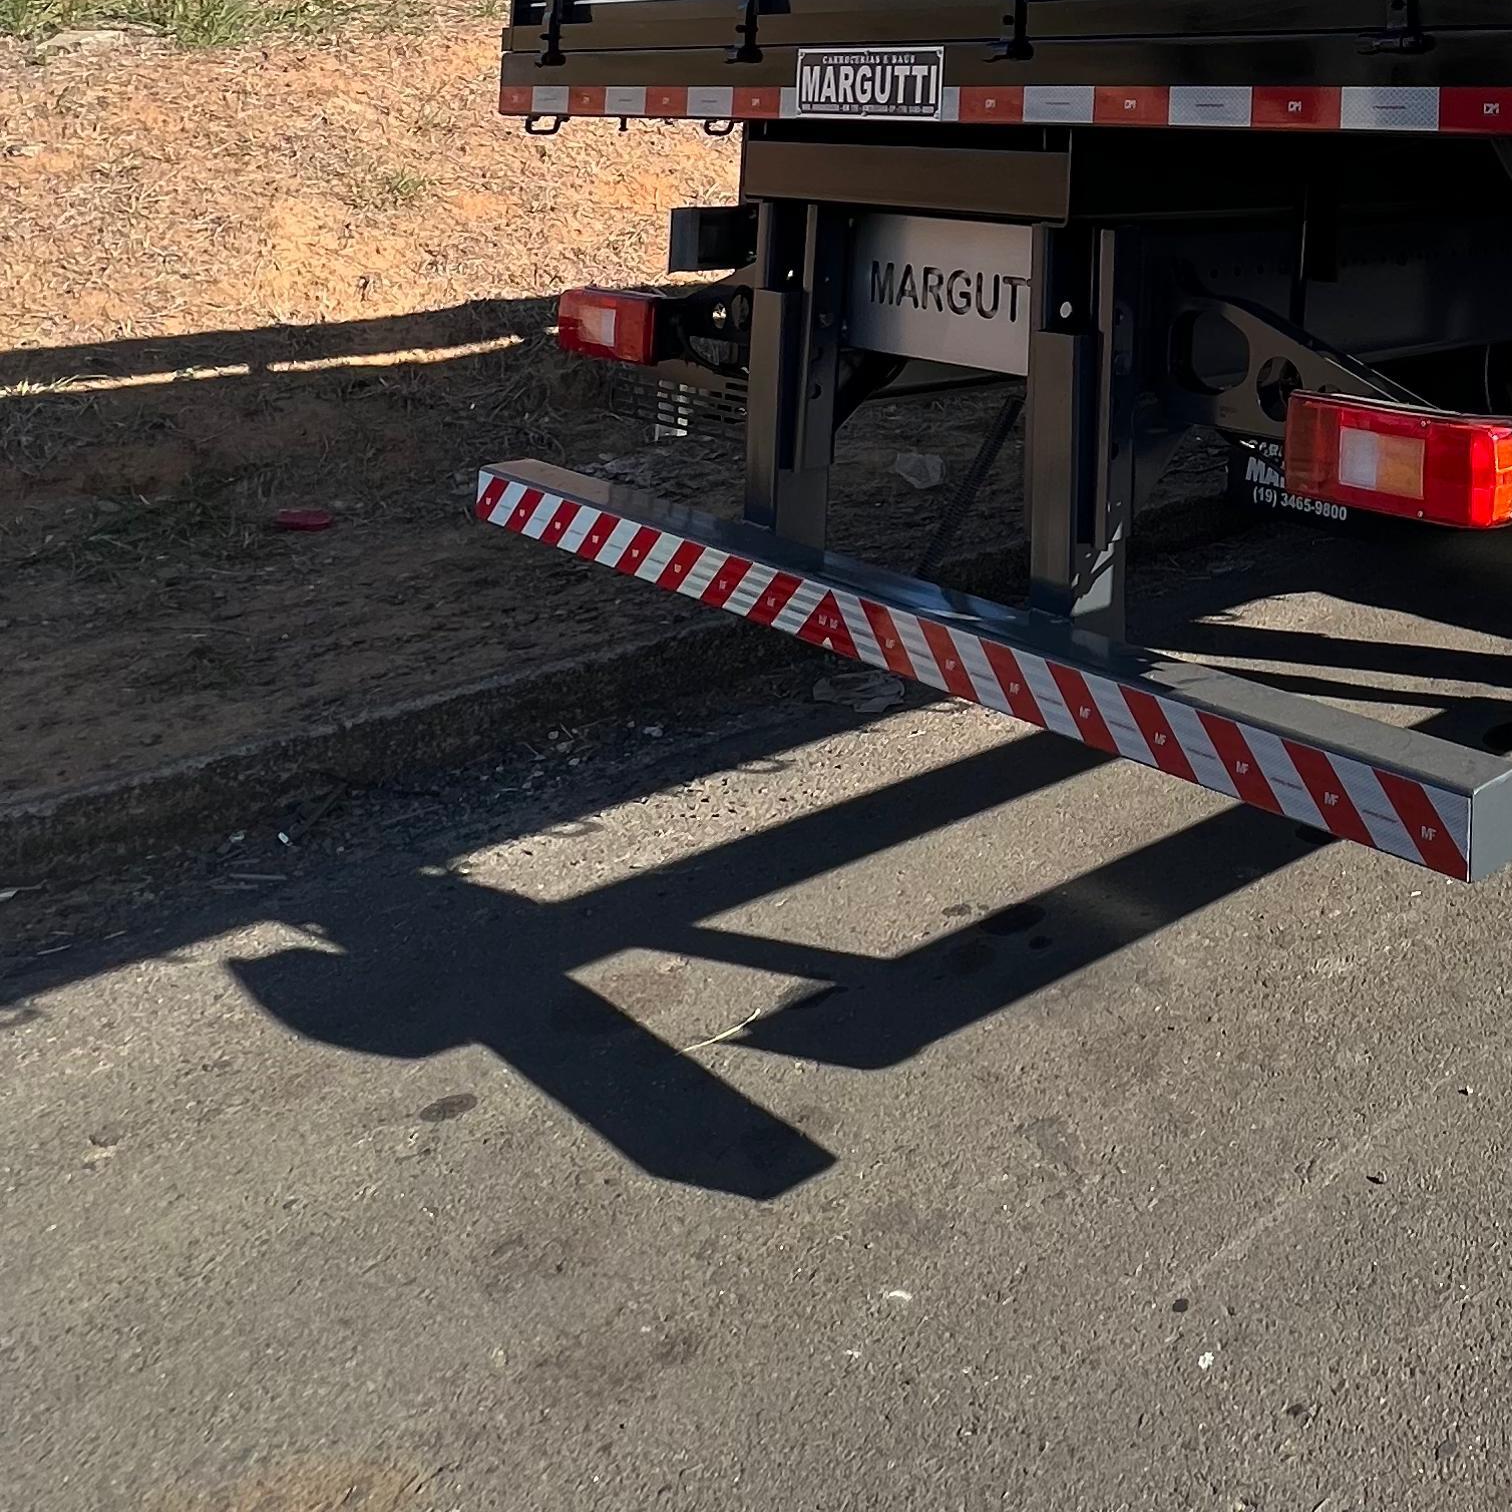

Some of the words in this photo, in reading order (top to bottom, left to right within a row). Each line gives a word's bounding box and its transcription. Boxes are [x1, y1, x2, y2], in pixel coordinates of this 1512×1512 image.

[802, 65, 937, 104] MARGUTTI
[871, 261, 1031, 323] MARGUT
[1253, 486, 1277, 508] (19)
[1281, 493, 1347, 521] 3465-9800
[1421, 825, 1437, 841] MF
